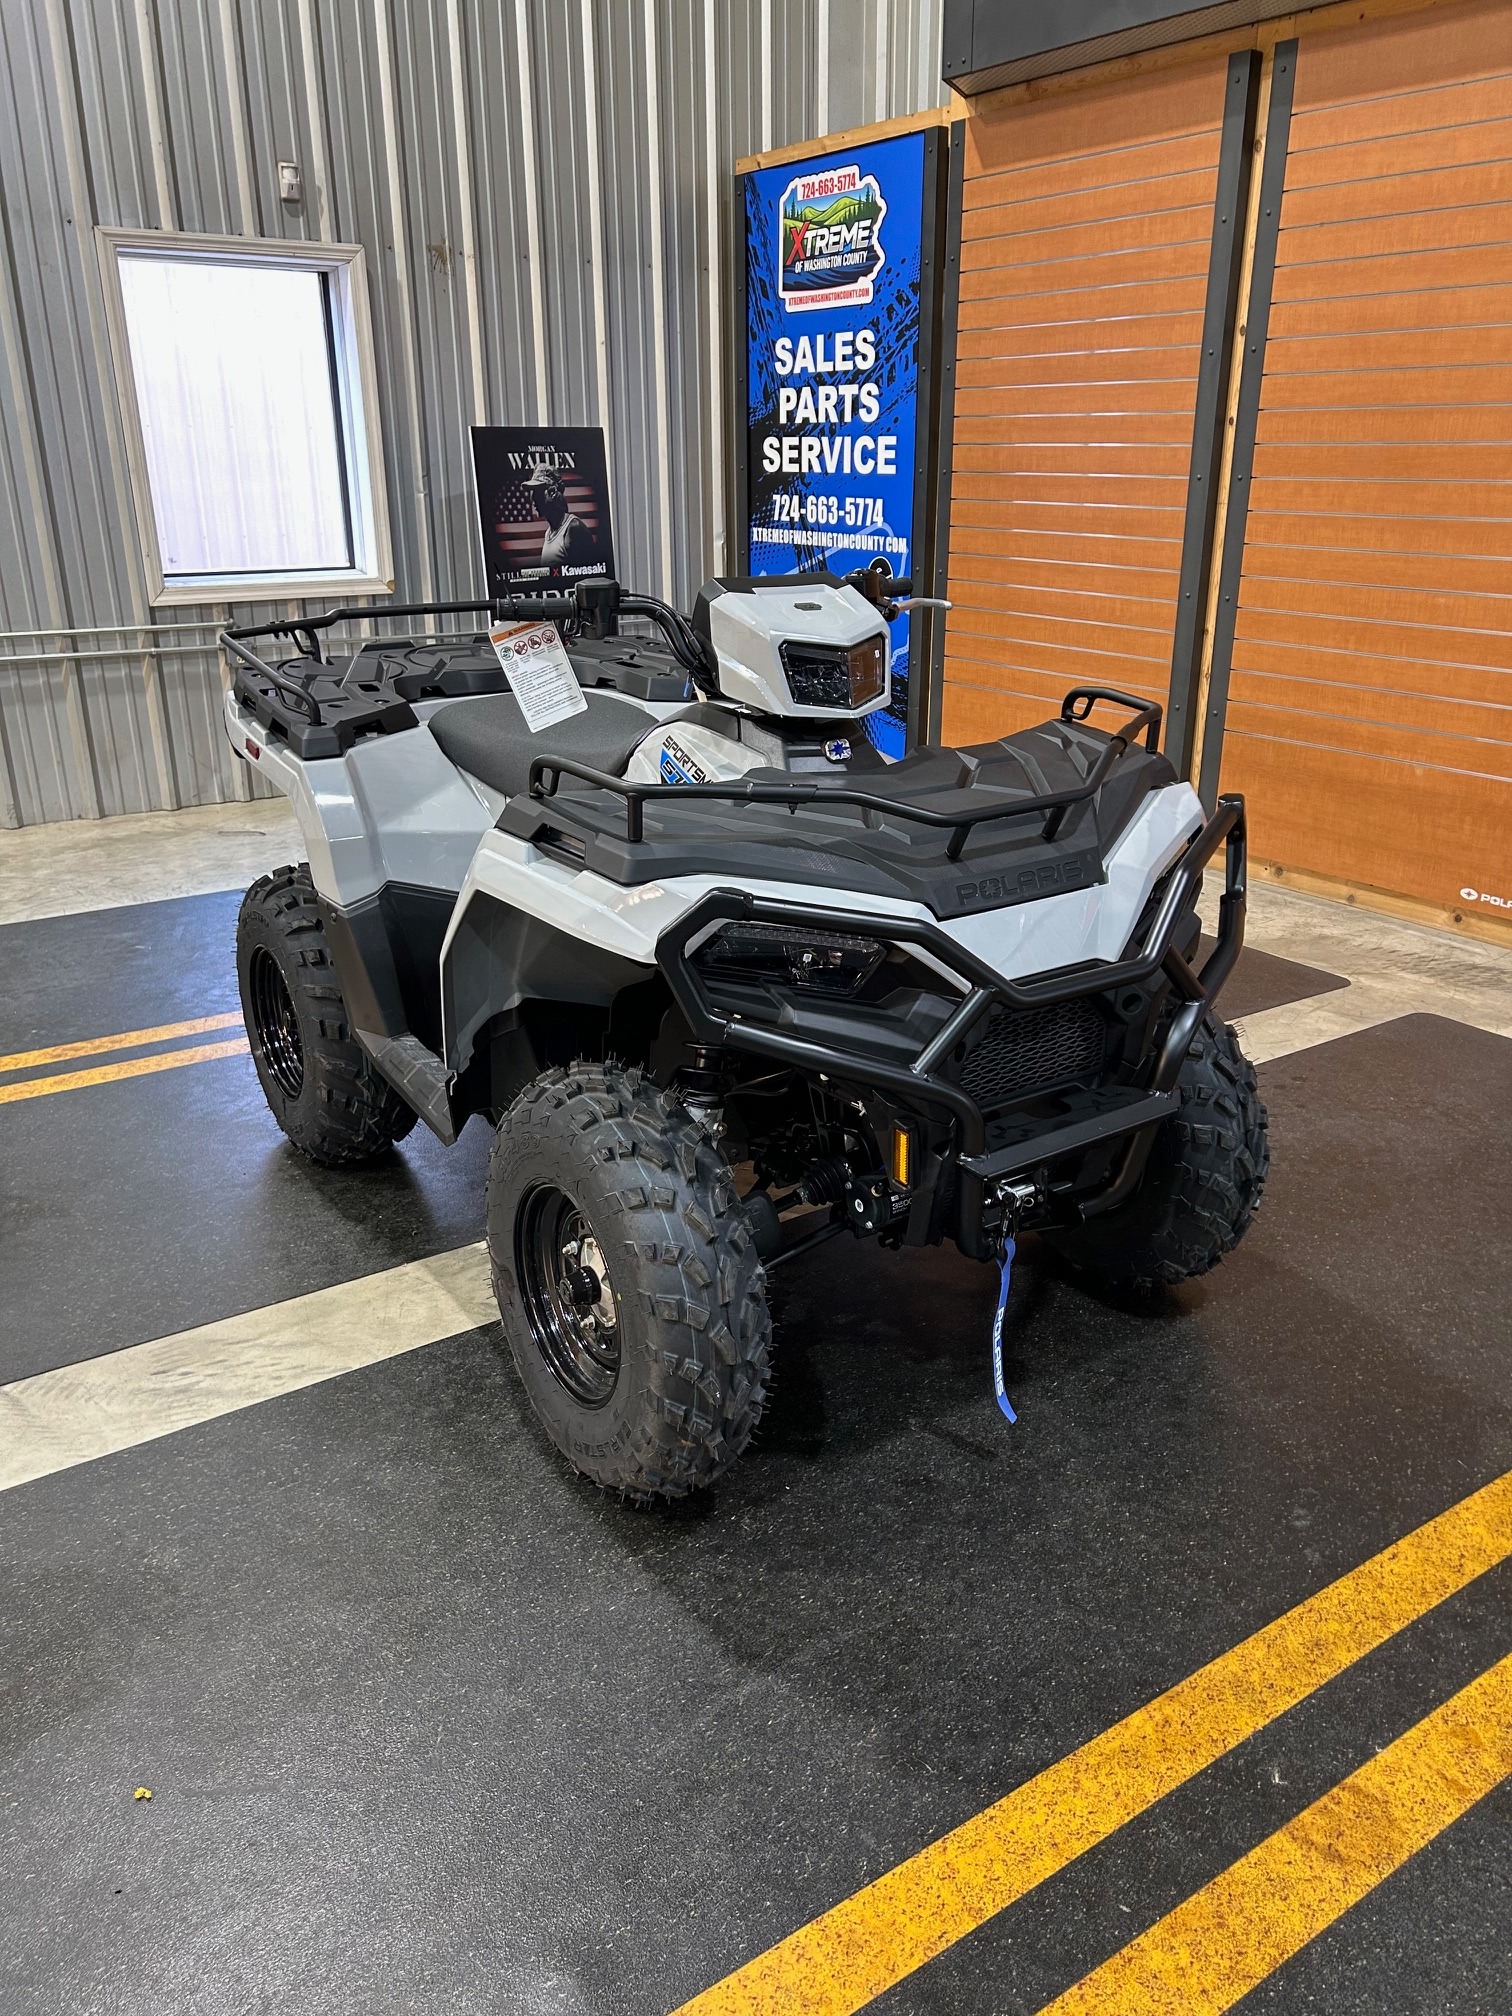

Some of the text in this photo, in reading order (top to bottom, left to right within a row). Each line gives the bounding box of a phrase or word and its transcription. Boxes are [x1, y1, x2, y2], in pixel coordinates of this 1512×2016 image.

[801, 172, 857, 200] 724-663-5774
[786, 220, 872, 265] XTREME
[794, 250, 869, 274] OF WASHINGTON COUNTY
[774, 329, 876, 376] SALES
[778, 382, 880, 425] PARTS
[762, 434, 898, 475] SERVICE
[772, 494, 884, 527] 724-663-5774
[495, 571, 521, 581] STILL
[561, 562, 607, 577] Kawasaki
[662, 734, 715, 784] SPORTSM
[955, 860, 1084, 906] POLARIS
[993, 1306, 1005, 1397] POLARIS
